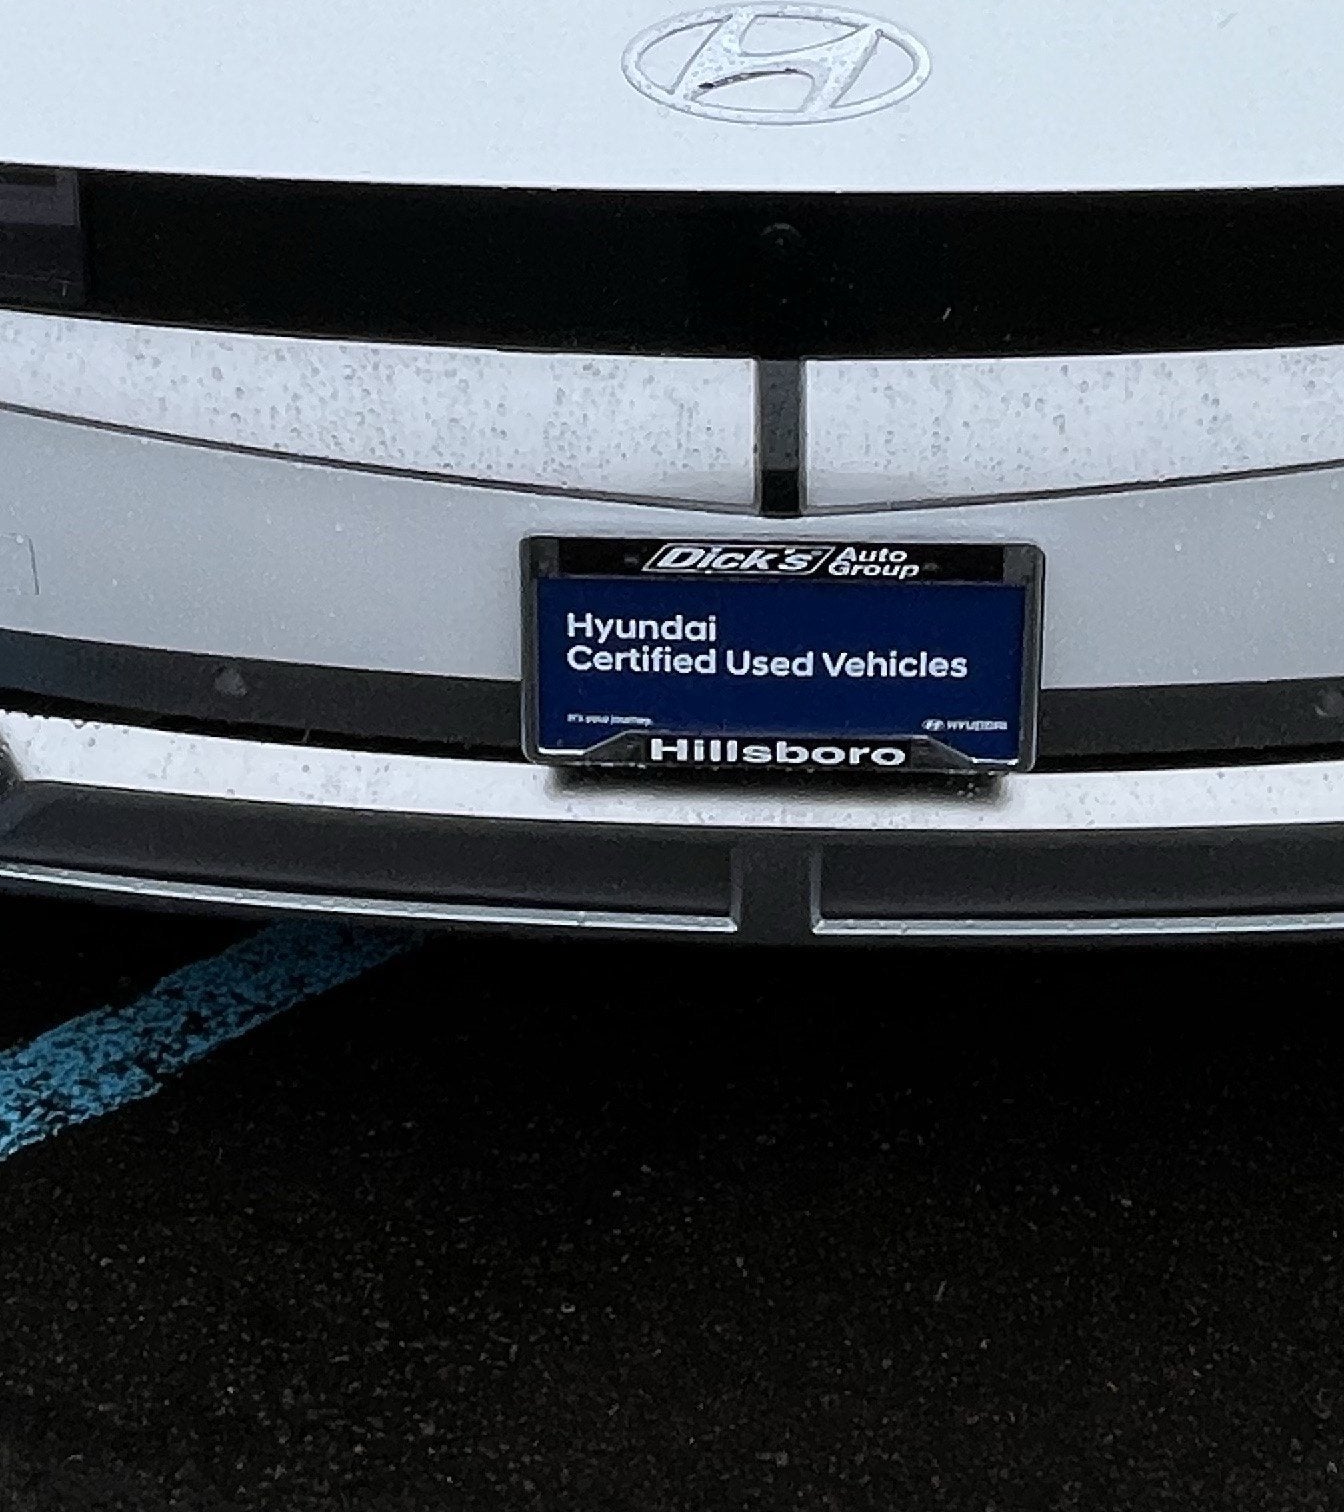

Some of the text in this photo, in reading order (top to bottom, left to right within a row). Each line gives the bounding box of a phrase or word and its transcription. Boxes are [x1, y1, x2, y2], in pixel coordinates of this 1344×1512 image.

[656, 546, 814, 572] Dick's
[835, 546, 908, 563] Auto
[828, 563, 920, 580] Group
[566, 612, 717, 643] Hyundai
[566, 645, 968, 679] Certified Used Vehicles
[650, 738, 906, 767] Hillsboro
